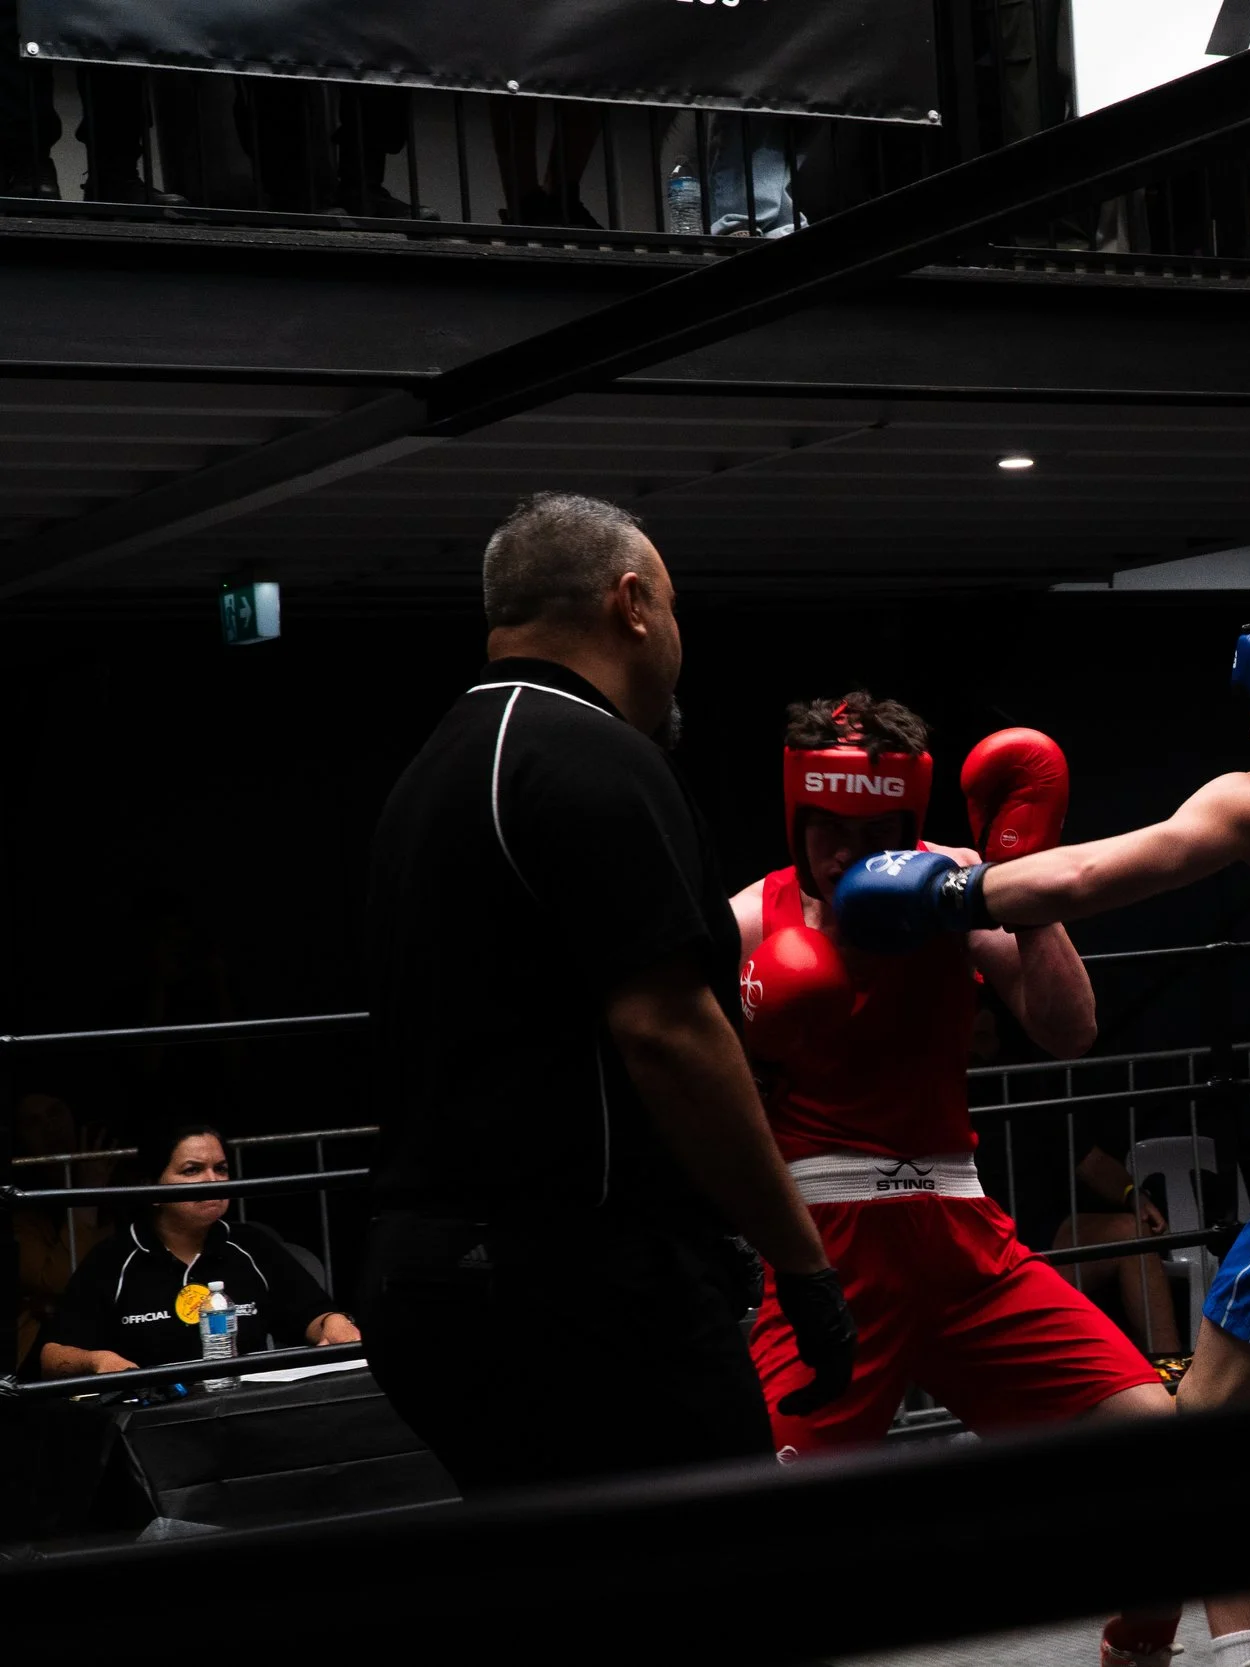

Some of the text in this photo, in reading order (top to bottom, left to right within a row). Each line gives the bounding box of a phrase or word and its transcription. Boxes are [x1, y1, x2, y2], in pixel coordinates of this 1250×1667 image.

[805, 772, 905, 797] STING
[876, 1179, 935, 1191] STING
[121, 1311, 172, 1325] OFFICIAL
